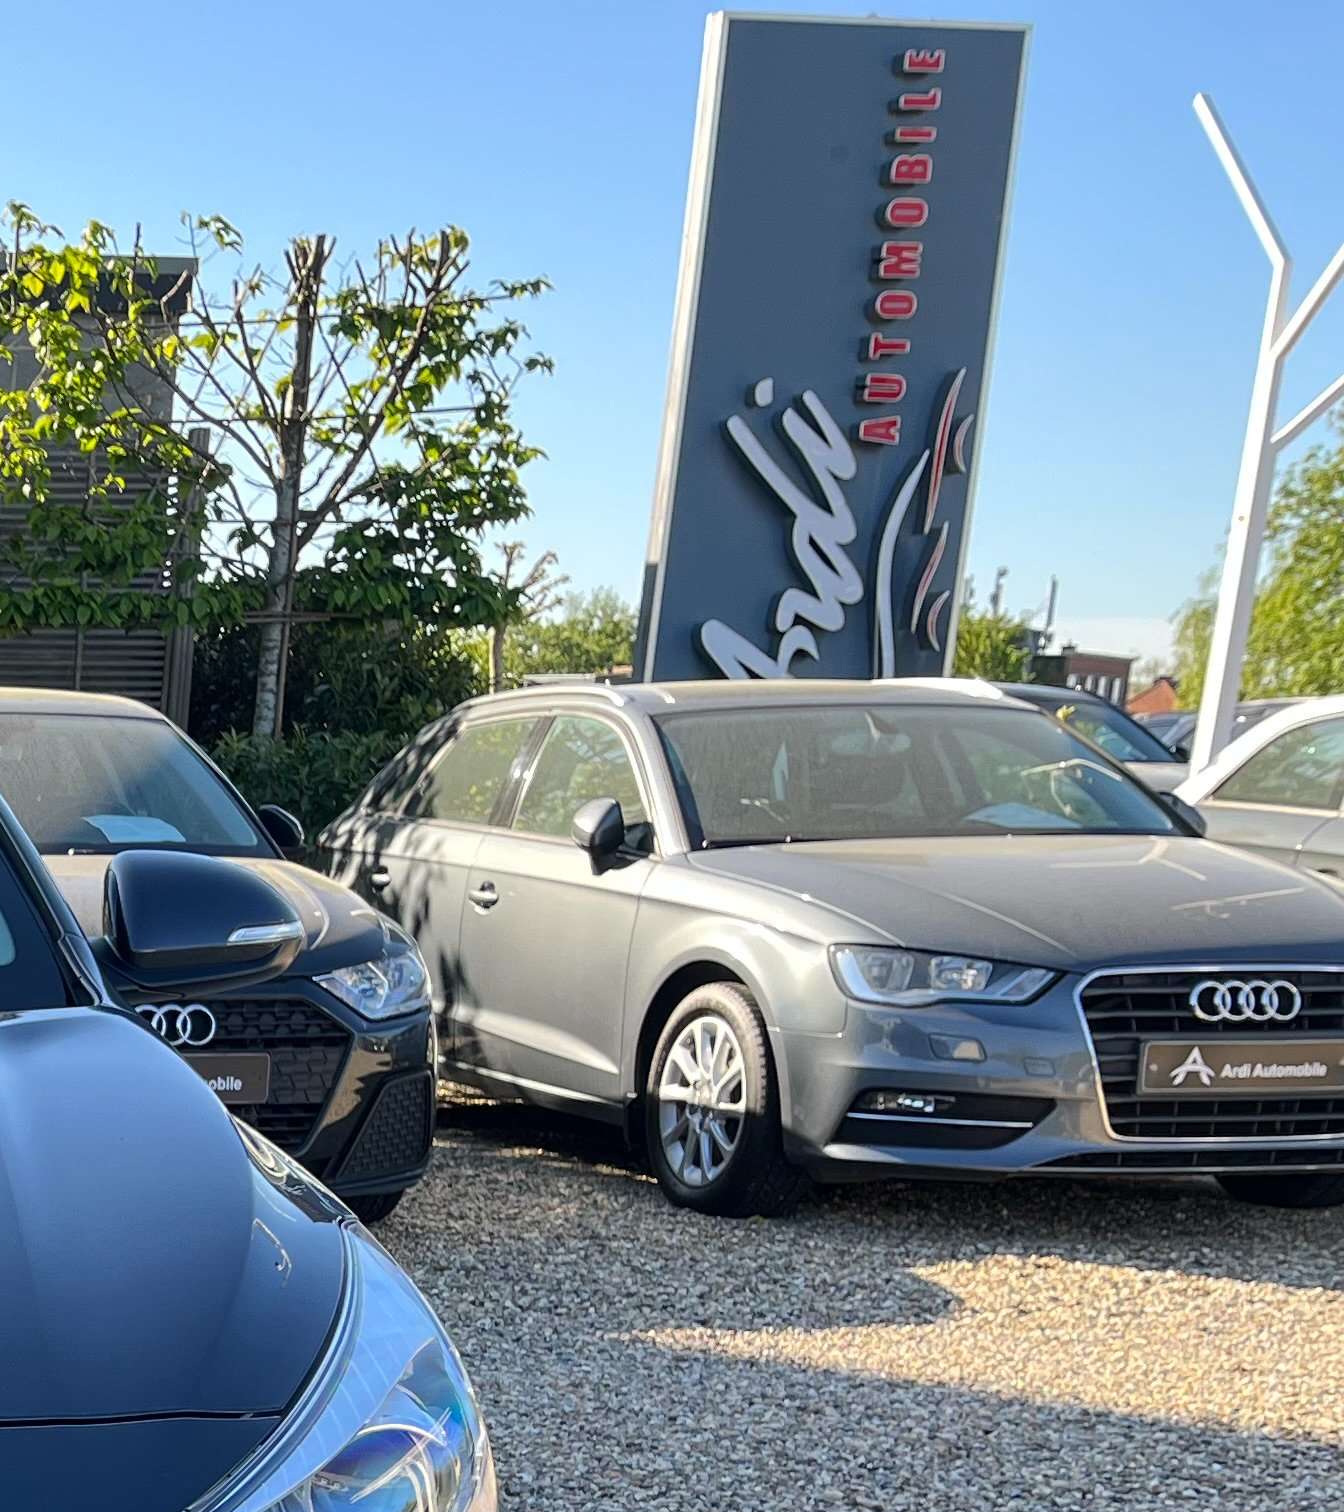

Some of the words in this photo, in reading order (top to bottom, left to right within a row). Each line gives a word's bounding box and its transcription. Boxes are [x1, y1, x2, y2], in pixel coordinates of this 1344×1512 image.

[858, 48, 946, 446] AUTOMOBILE
[1220, 1063, 1252, 1079] Ardi
[1252, 1062, 1328, 1079] Automobile
